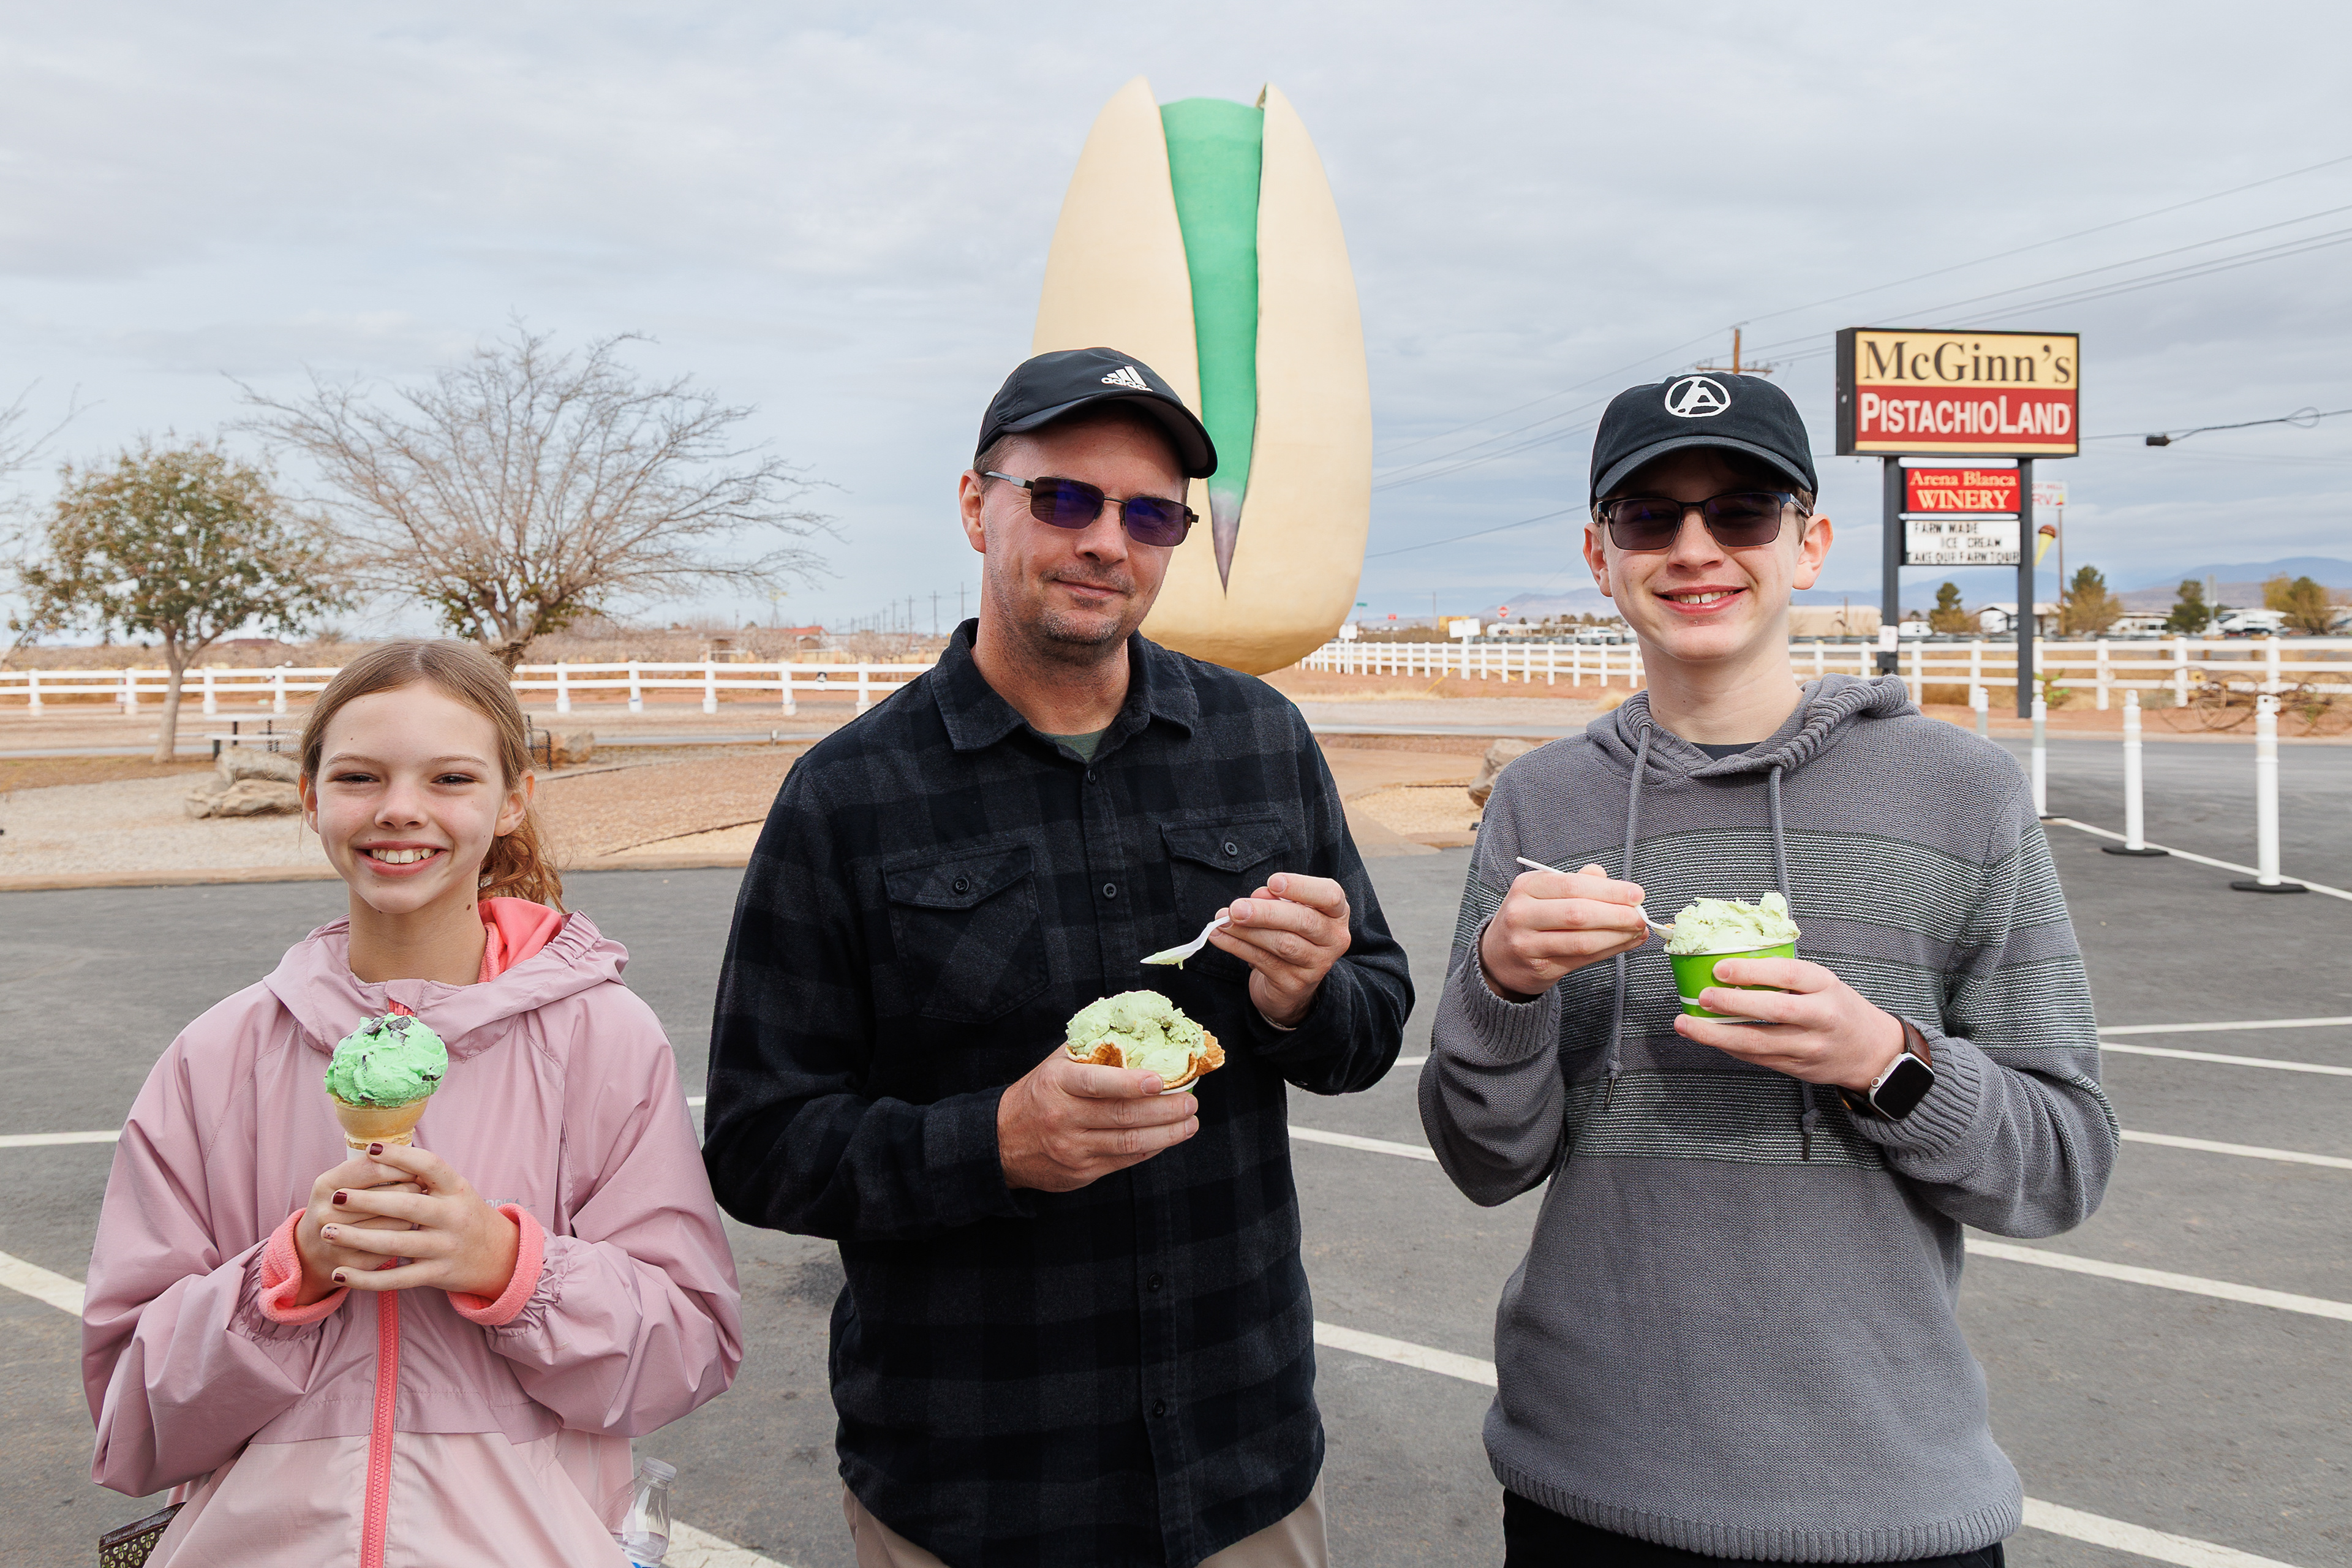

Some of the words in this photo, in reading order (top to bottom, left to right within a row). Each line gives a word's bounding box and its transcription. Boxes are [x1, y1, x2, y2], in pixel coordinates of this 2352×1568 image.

[1863, 341, 2071, 384] McGinn's
[1860, 392, 2071, 435] PISTACHIOLAND
[1909, 470, 1959, 486] Arena
[1962, 470, 2018, 487] Blanca
[1916, 489, 2011, 510] WINERY
[1940, 537, 1958, 548] ICE
